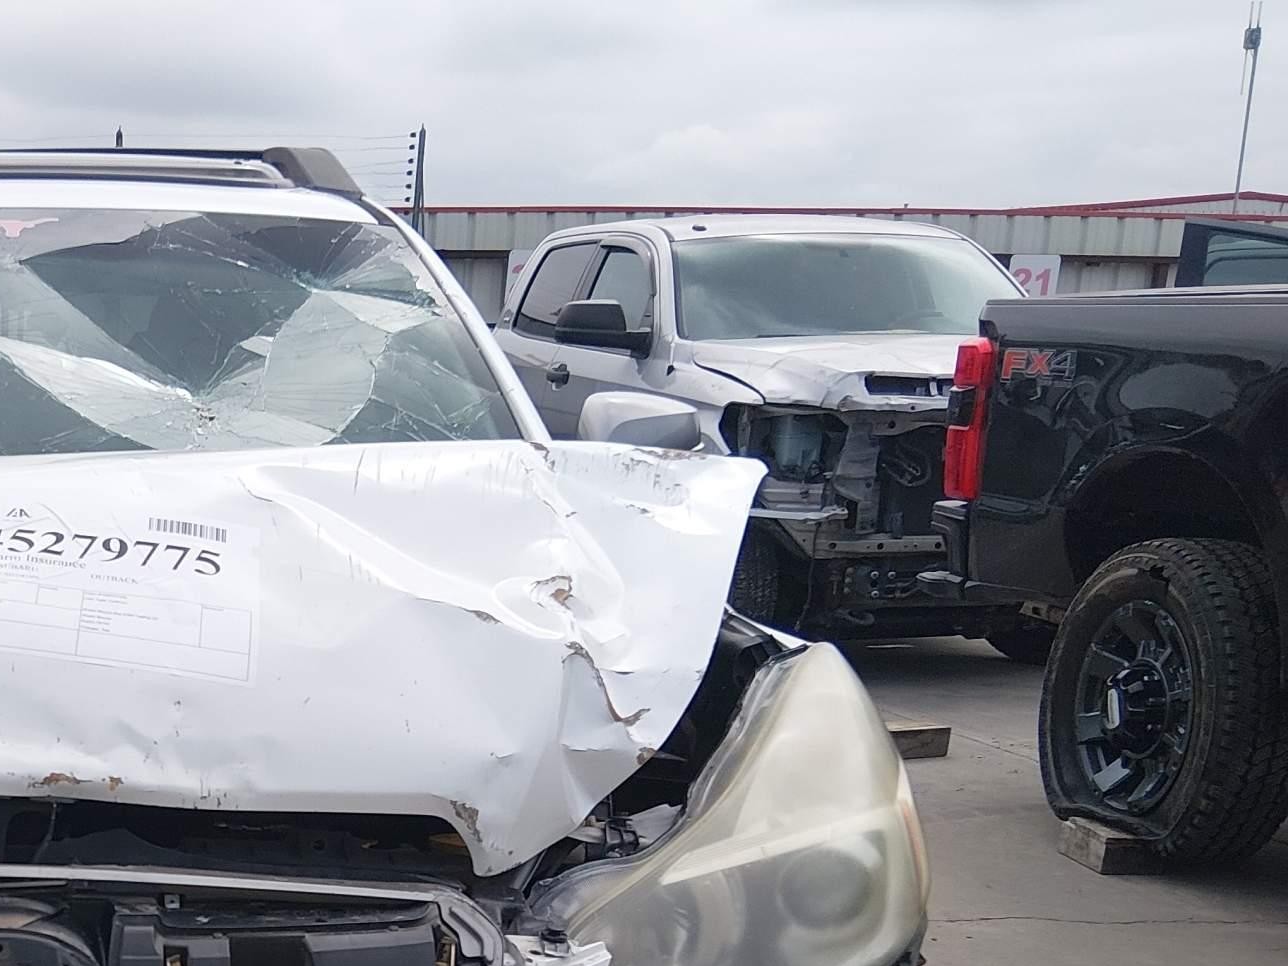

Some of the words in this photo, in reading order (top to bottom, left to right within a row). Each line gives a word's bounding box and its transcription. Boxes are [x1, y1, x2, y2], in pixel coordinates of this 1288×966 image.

[999, 347, 1078, 383] FX4
[26, 553, 87, 569] Insurance
[90, 573, 138, 585] OUTBACK
